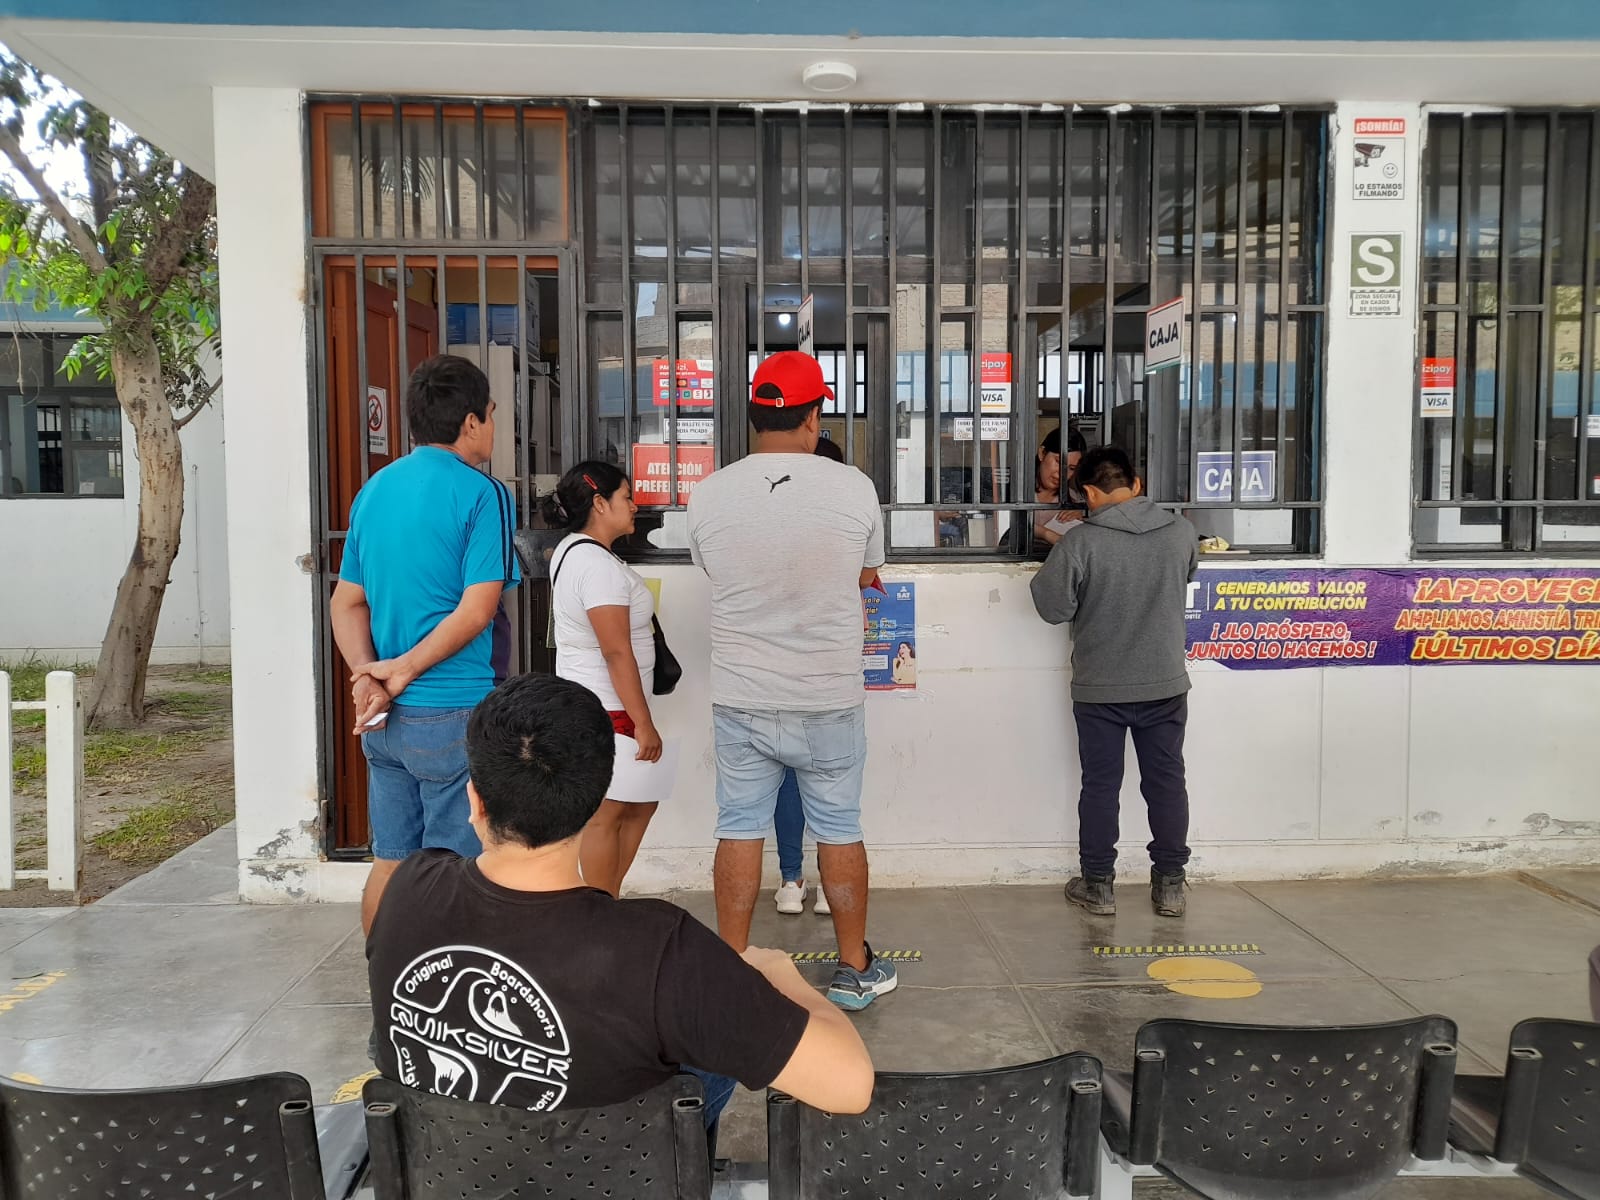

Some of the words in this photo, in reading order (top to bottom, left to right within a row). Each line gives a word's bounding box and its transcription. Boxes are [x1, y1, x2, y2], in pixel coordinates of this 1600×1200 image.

[1357, 238, 1395, 283] S
[1149, 321, 1179, 349] CAJA
[981, 360, 1007, 370] zipay
[1422, 364, 1451, 374] izipay
[982, 394, 1003, 402] VISA
[1427, 398, 1448, 407] VISA
[1216, 582, 1310, 595] GENERAMOS
[1317, 582, 1366, 595] VALOR
[1214, 598, 1226, 610] A
[1230, 598, 1251, 611] TU
[1253, 594, 1367, 610] CONTRIBUCIÓN
[1395, 609, 1493, 631] AMPLIAMOS
[1494, 604, 1571, 631] AMNISTÍA
[1220, 622, 1253, 640] JLO
[1254, 618, 1351, 640] PRÓSPERO,
[1186, 641, 1256, 659] JUNTOS
[1257, 641, 1280, 659] LO
[1282, 641, 1367, 659] HACEMOS
[1411, 631, 1555, 660] ¡ÚLTIMOS
[405, 954, 453, 994] Original
[490, 961, 556, 1039] Boardshorts
[391, 1003, 569, 1081] QUIKSILVER
